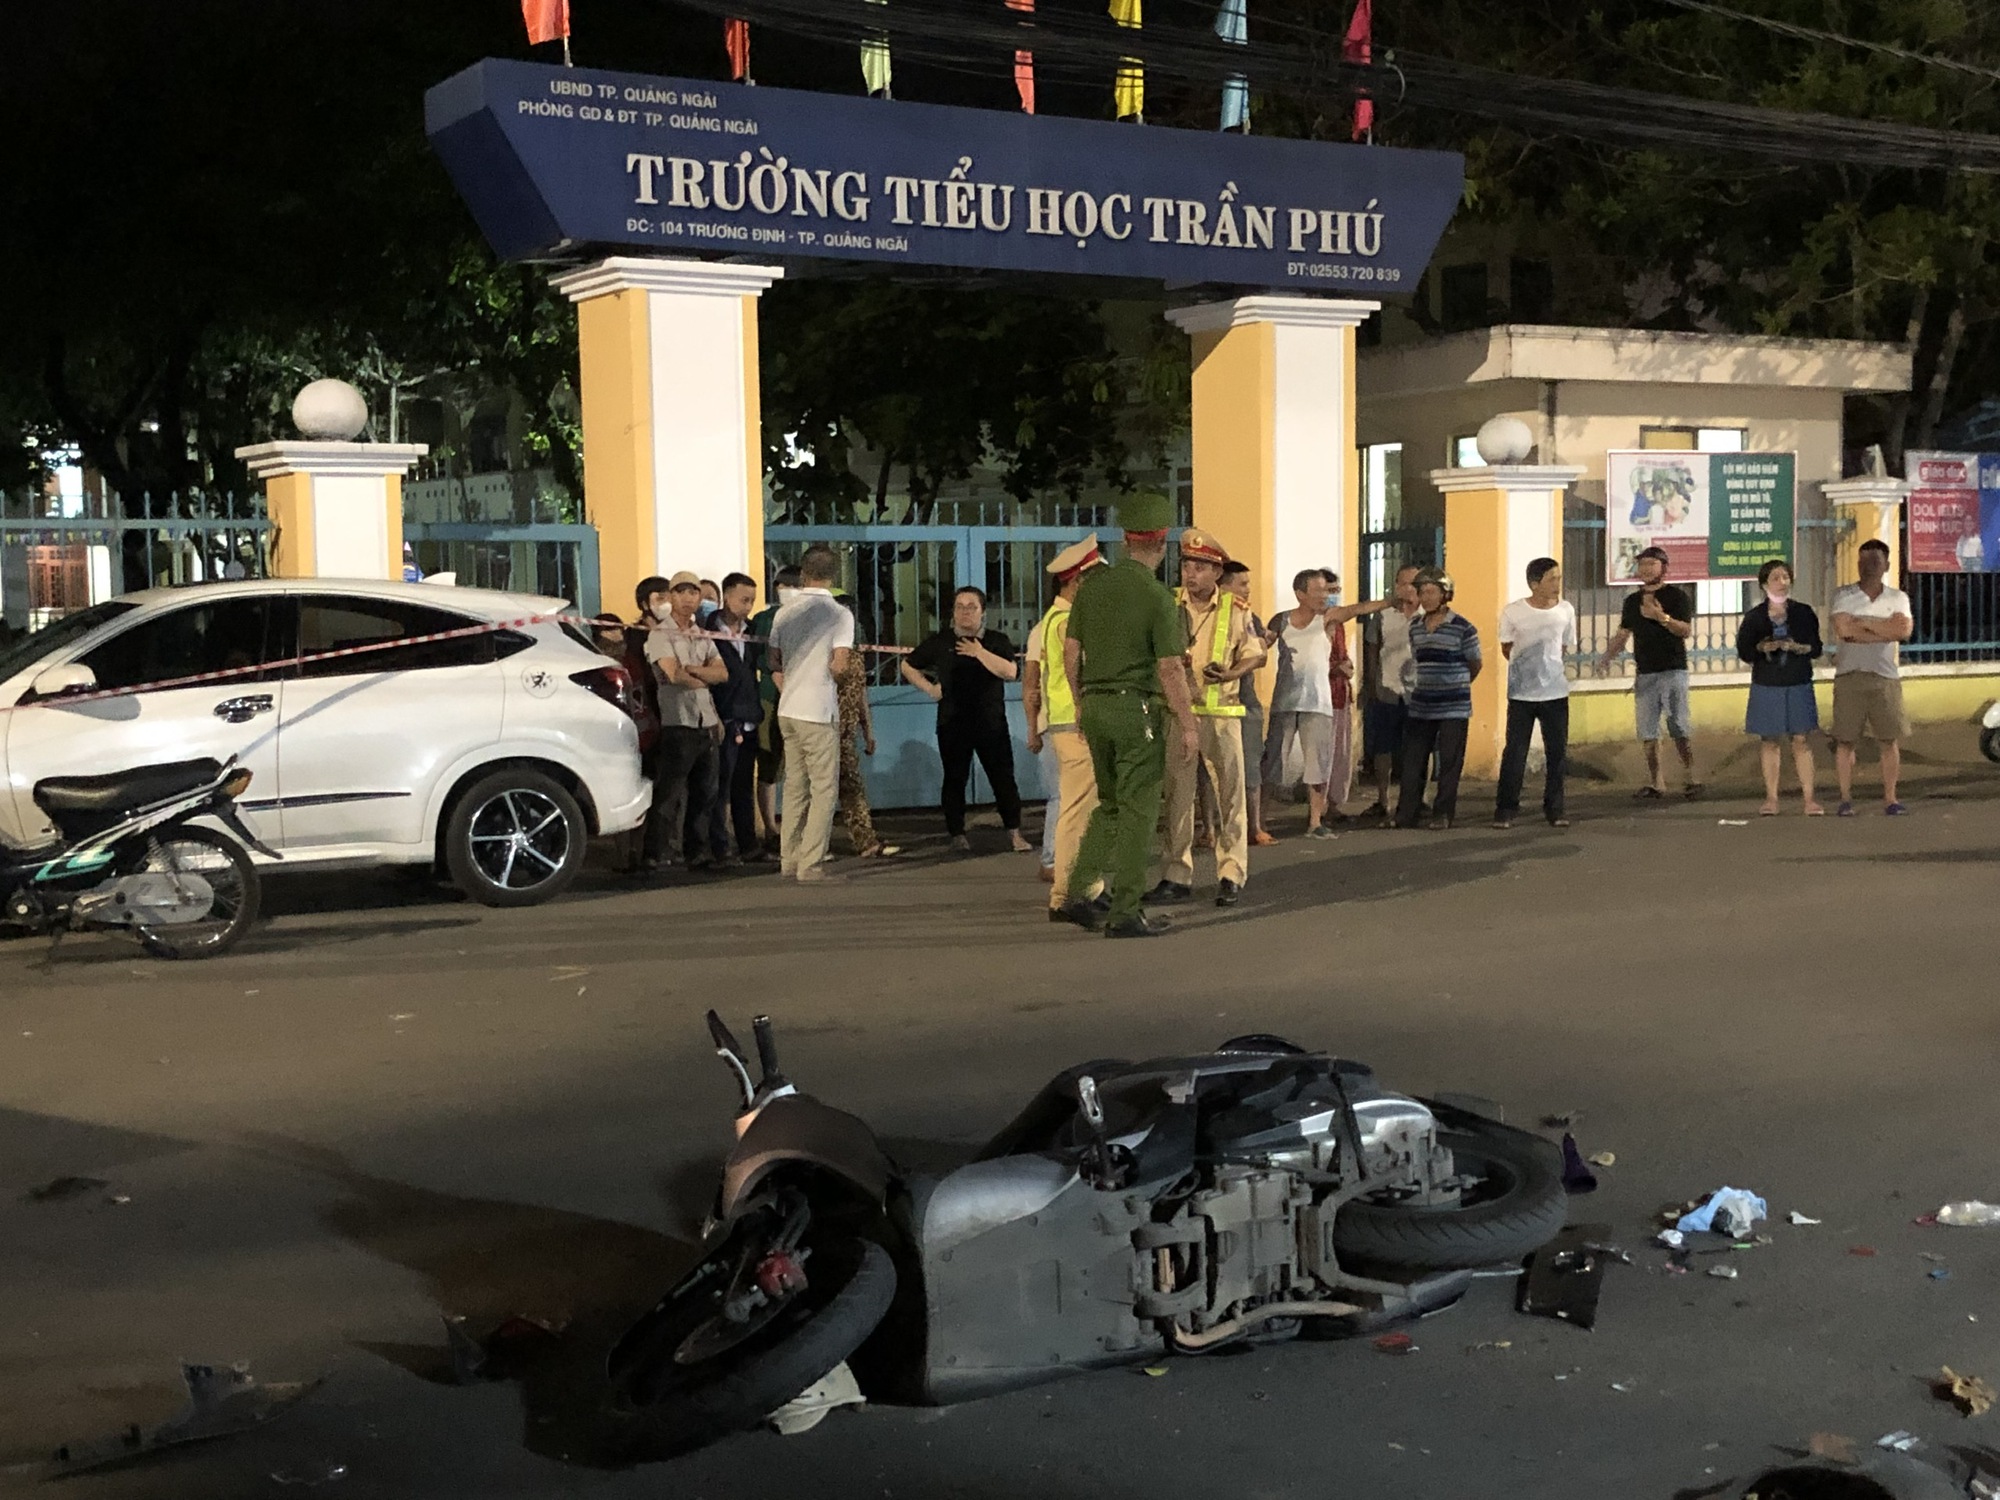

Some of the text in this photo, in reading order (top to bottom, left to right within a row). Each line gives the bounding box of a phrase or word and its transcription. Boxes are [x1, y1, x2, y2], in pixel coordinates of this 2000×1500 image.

[550, 80, 717, 108] UBND TP. QUẢNG NGÃI
[579, 106, 601, 121] GD
[604, 109, 614, 121] &
[617, 109, 638, 124] ĐT
[643, 112, 665, 127] TP.
[670, 112, 721, 132] QUẢNG
[724, 118, 758, 135] NGÃI
[627, 146, 1384, 256] TRƯỜNG TIỂU HỌC TRẦN PHÚ
[626, 218, 654, 233] ĐC:
[659, 221, 683, 236] 104
[687, 223, 748, 240] TRƯƠNG
[752, 229, 785, 244] ĐỊNH
[798, 231, 819, 246] TP.
[823, 230, 872, 249] QUẢNG
[875, 234, 908, 252] NGÃI
[1376, 268, 1400, 281] 839
